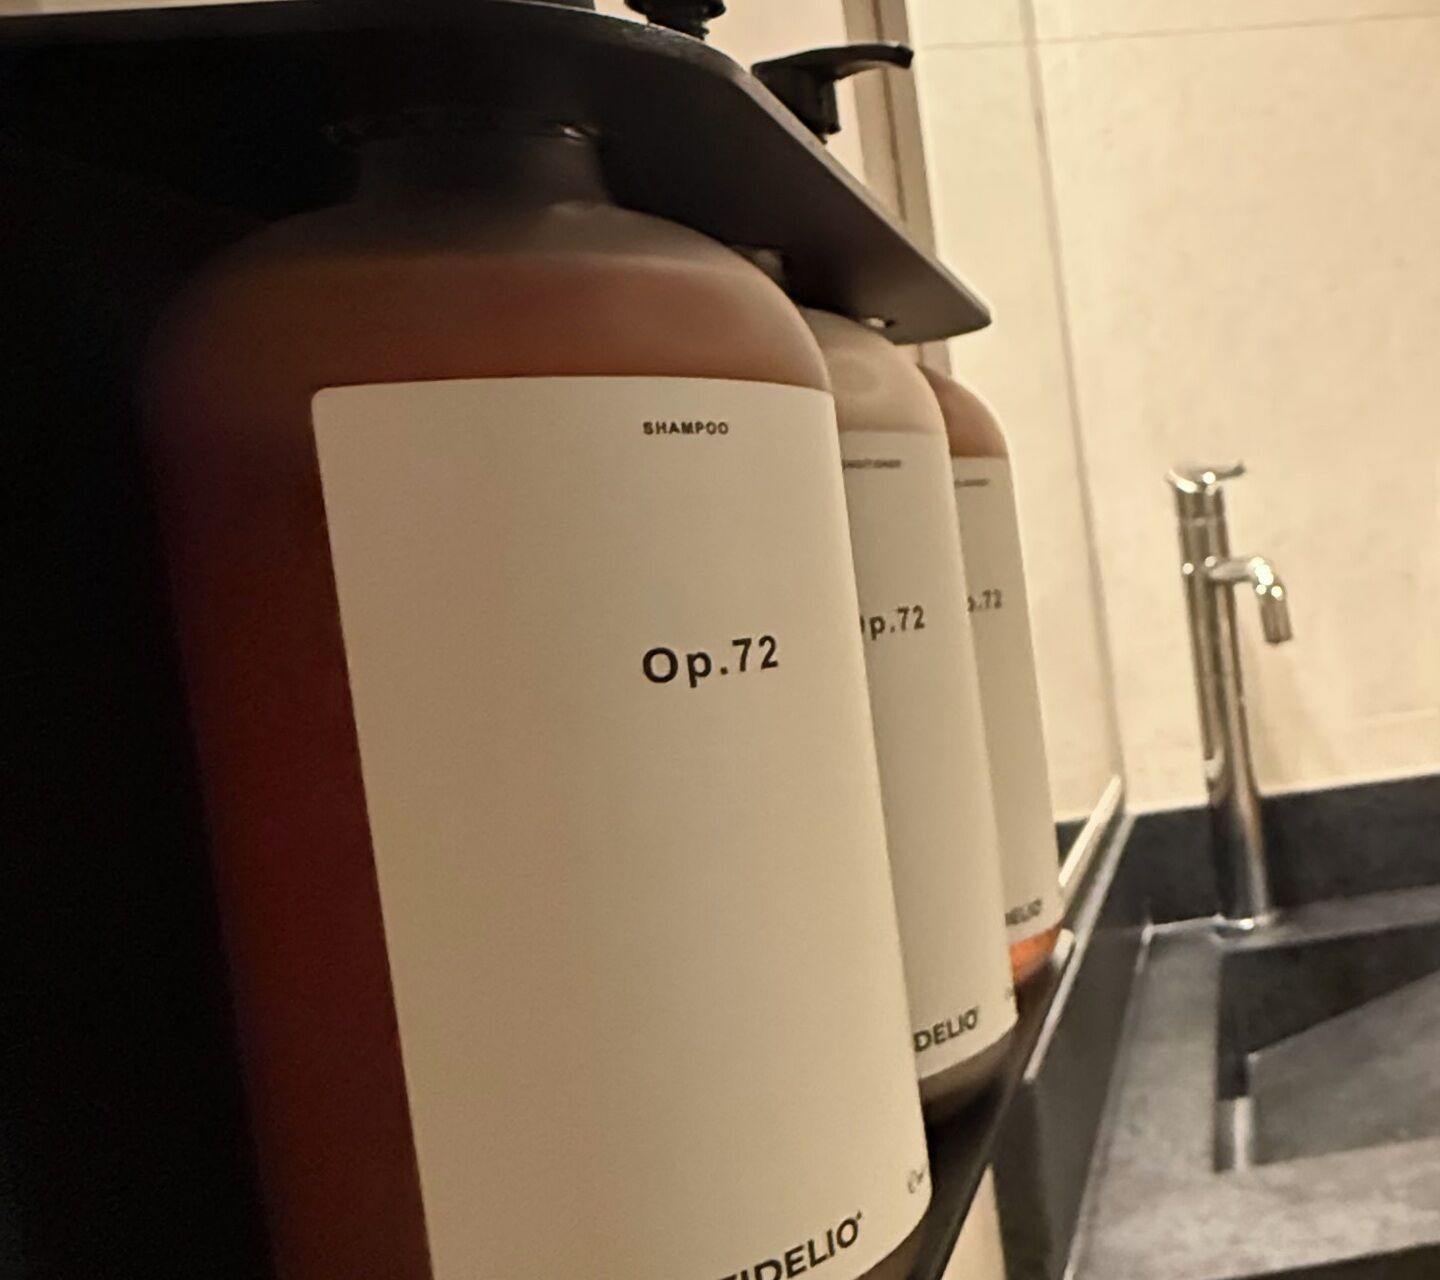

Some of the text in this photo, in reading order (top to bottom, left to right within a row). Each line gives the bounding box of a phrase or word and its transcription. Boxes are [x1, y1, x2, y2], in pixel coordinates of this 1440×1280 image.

[642, 420, 729, 435] SHAMPOO
[859, 605, 925, 641] p.72
[642, 635, 779, 688] Op.72
